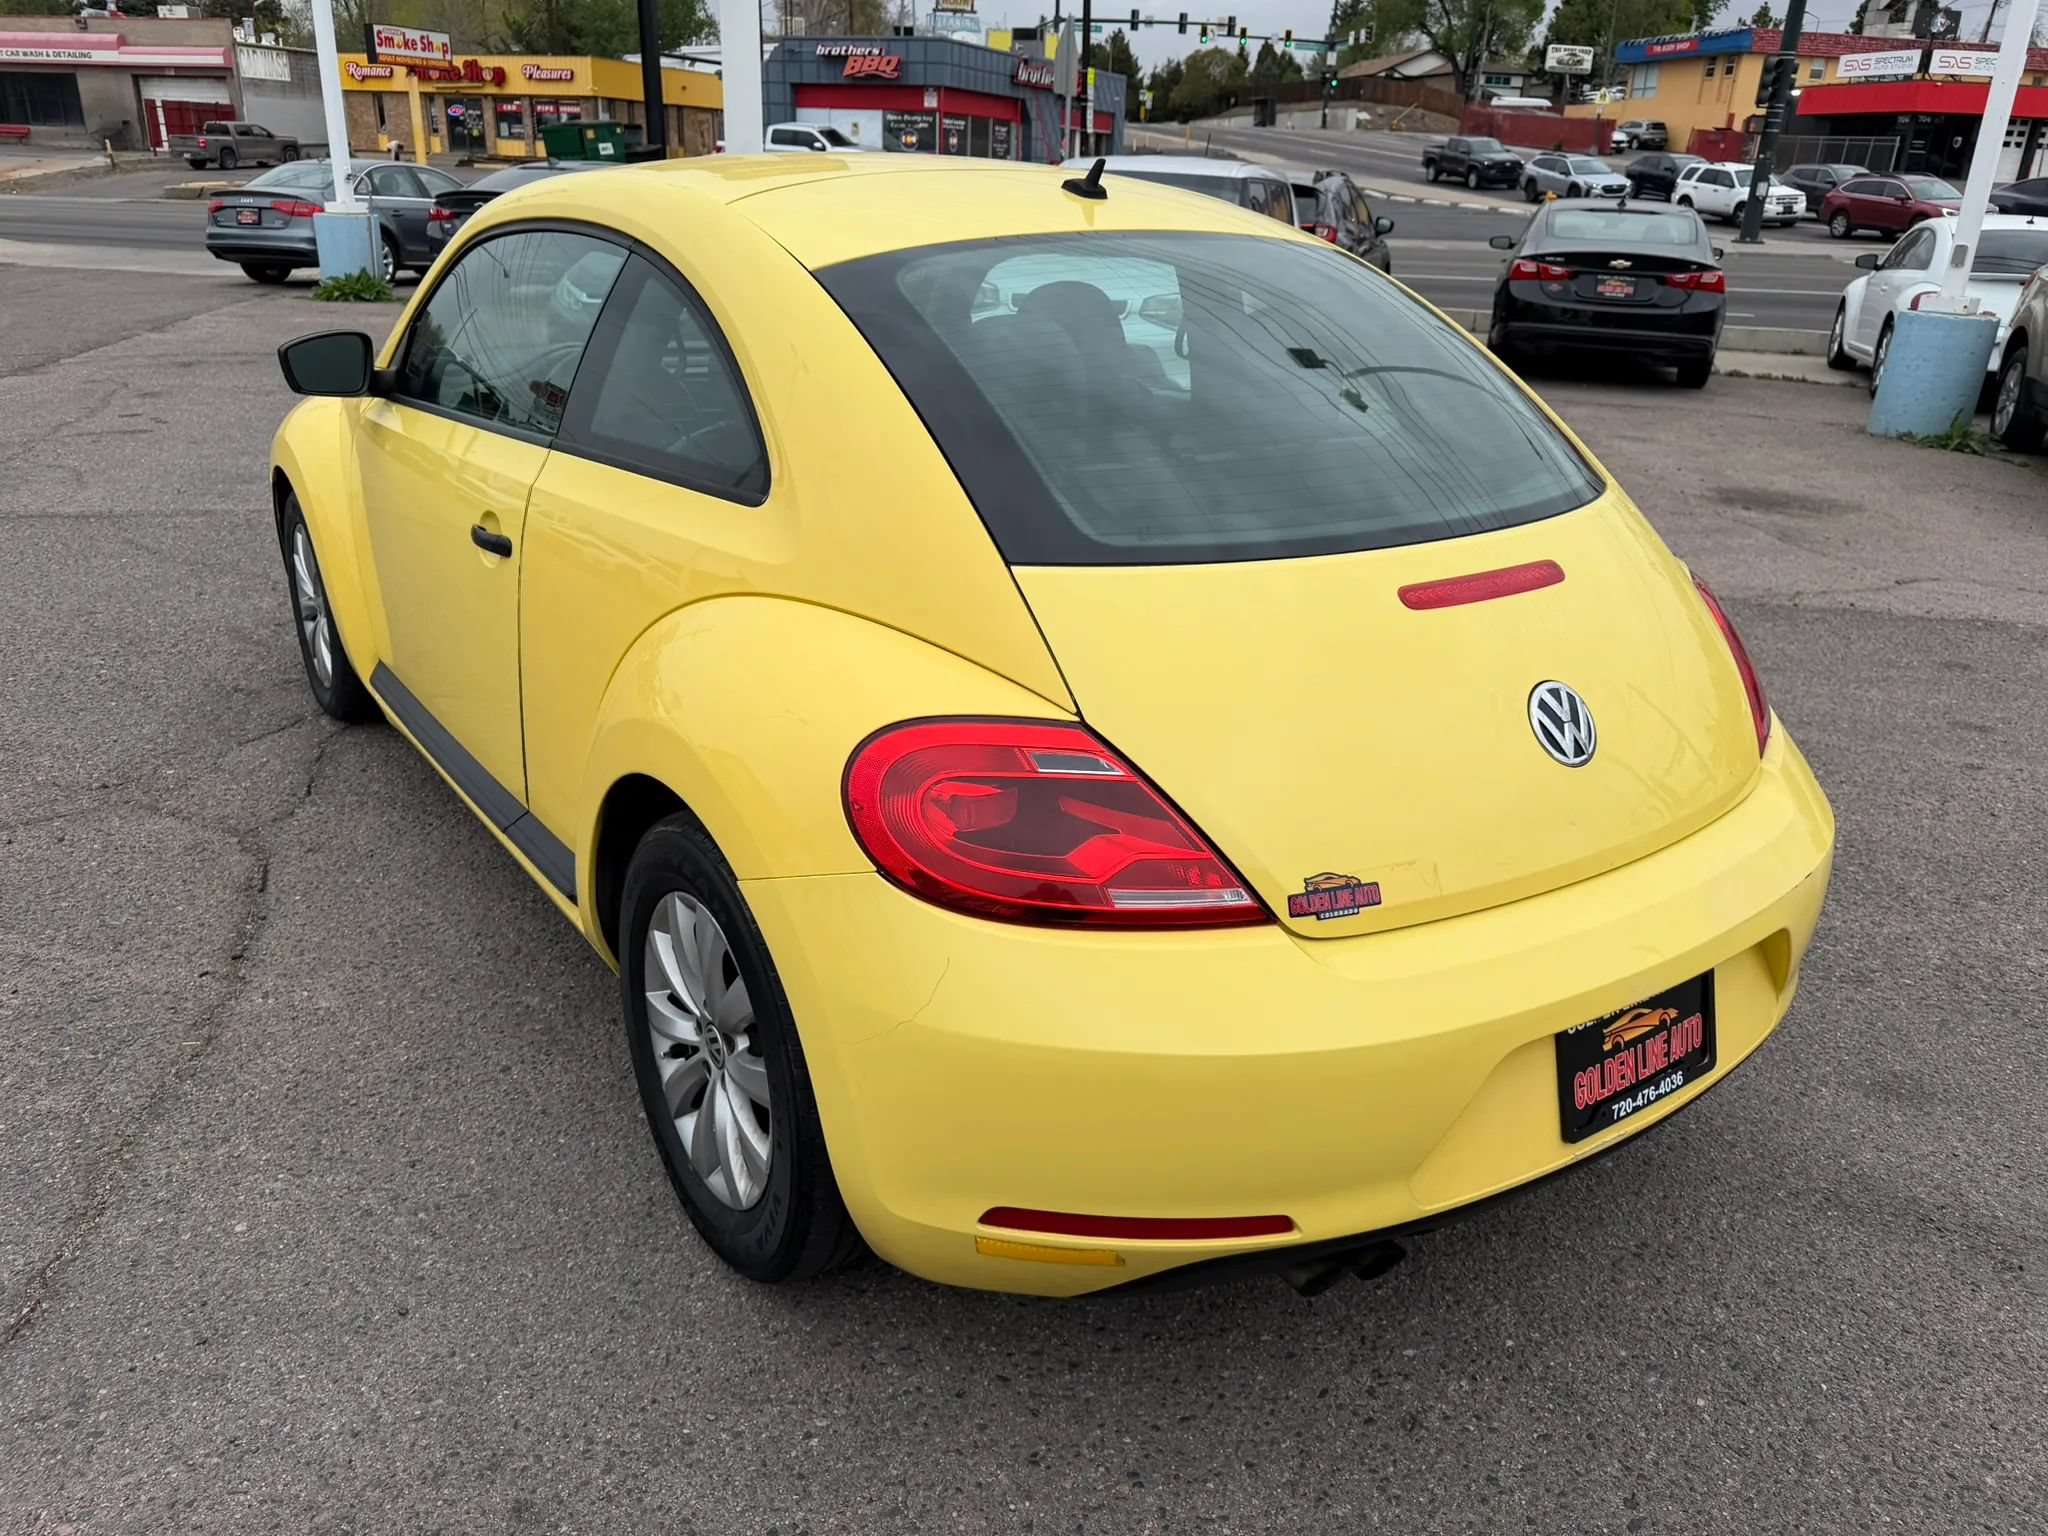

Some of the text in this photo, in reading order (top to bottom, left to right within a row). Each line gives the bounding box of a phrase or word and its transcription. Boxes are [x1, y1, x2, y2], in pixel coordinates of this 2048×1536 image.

[377, 30, 449, 59] Smoke Shop
[815, 44, 882, 56] brothers
[21, 50, 43, 58] WASH
[52, 51, 92, 59] DETAILING
[1874, 56, 1914, 65] SPECTRUM
[1975, 57, 1998, 65] SPEC
[345, 62, 393, 81] Romance
[462, 59, 506, 88] Shop
[522, 64, 572, 80] Pleasures
[843, 56, 901, 78] BBQ
[1290, 885, 1380, 915] GOLDEN LINE AUTO
[1320, 908, 1358, 918] COLORADO
[1574, 1047, 1635, 1110] GOLDEN
[1637, 1030, 1668, 1080] LINE
[1670, 1012, 1702, 1063] AUTO
[1611, 1071, 1684, 1120] 720-476-4036
